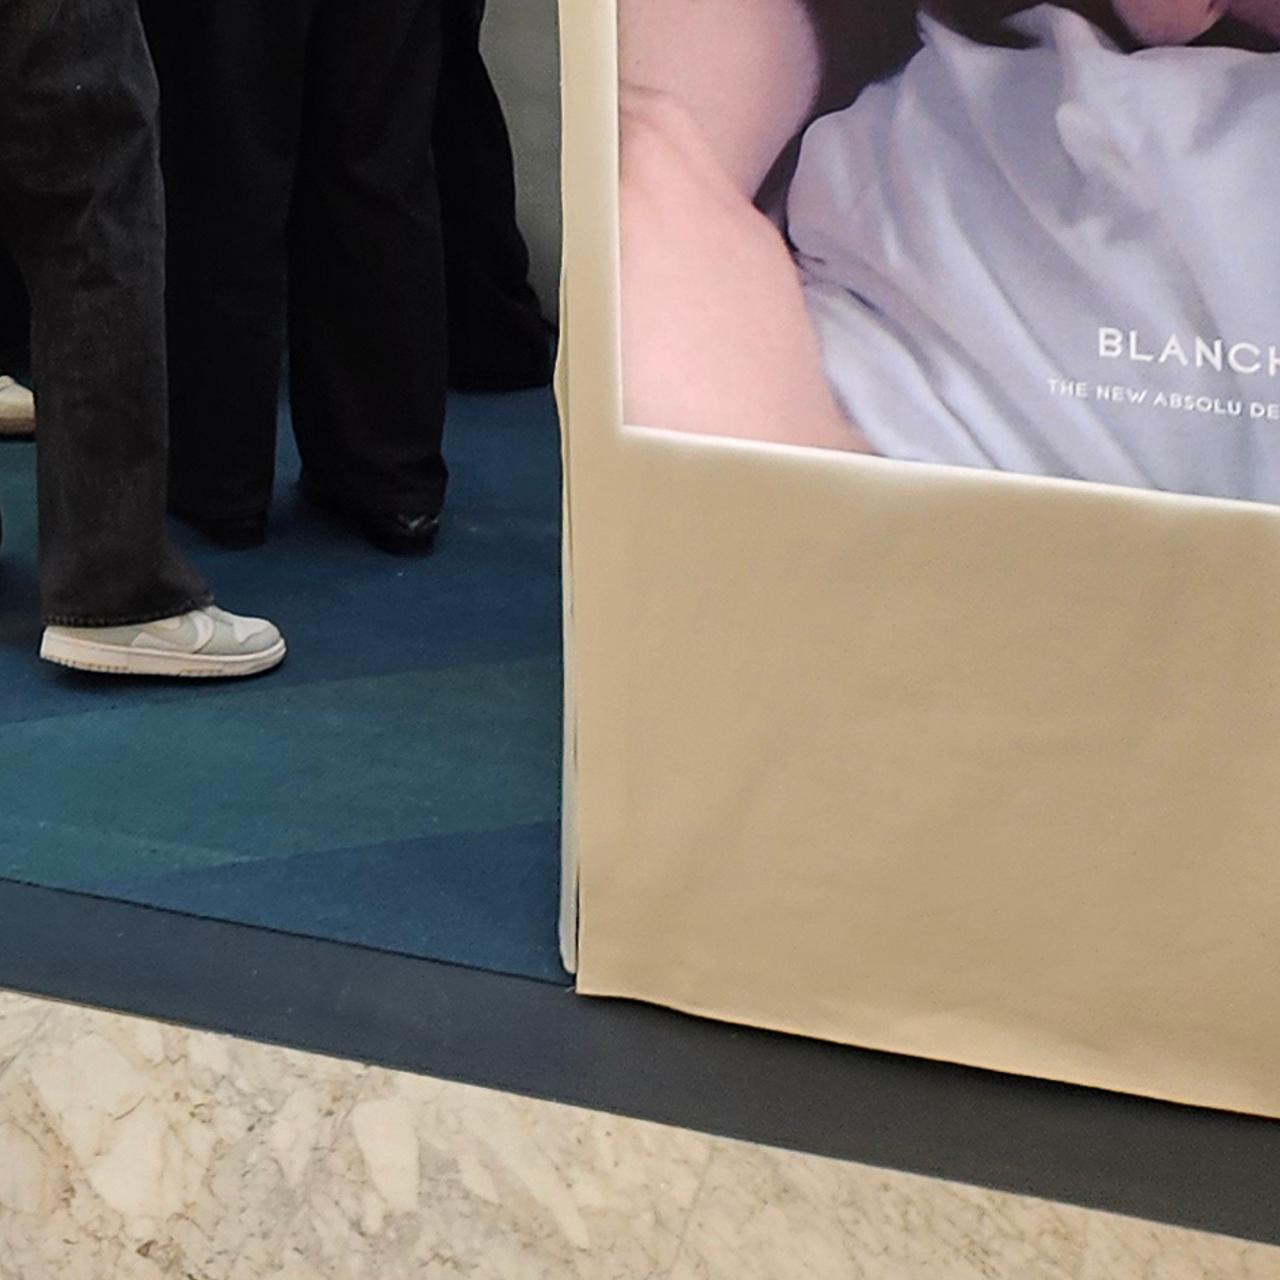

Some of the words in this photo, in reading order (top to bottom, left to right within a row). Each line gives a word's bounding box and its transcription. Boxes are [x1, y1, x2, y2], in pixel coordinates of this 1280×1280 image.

[1047, 378, 1088, 399] THE
[1096, 385, 1148, 404] NEW
[1153, 391, 1242, 416] ABSOLU
[1249, 401, 1280, 421] DE
